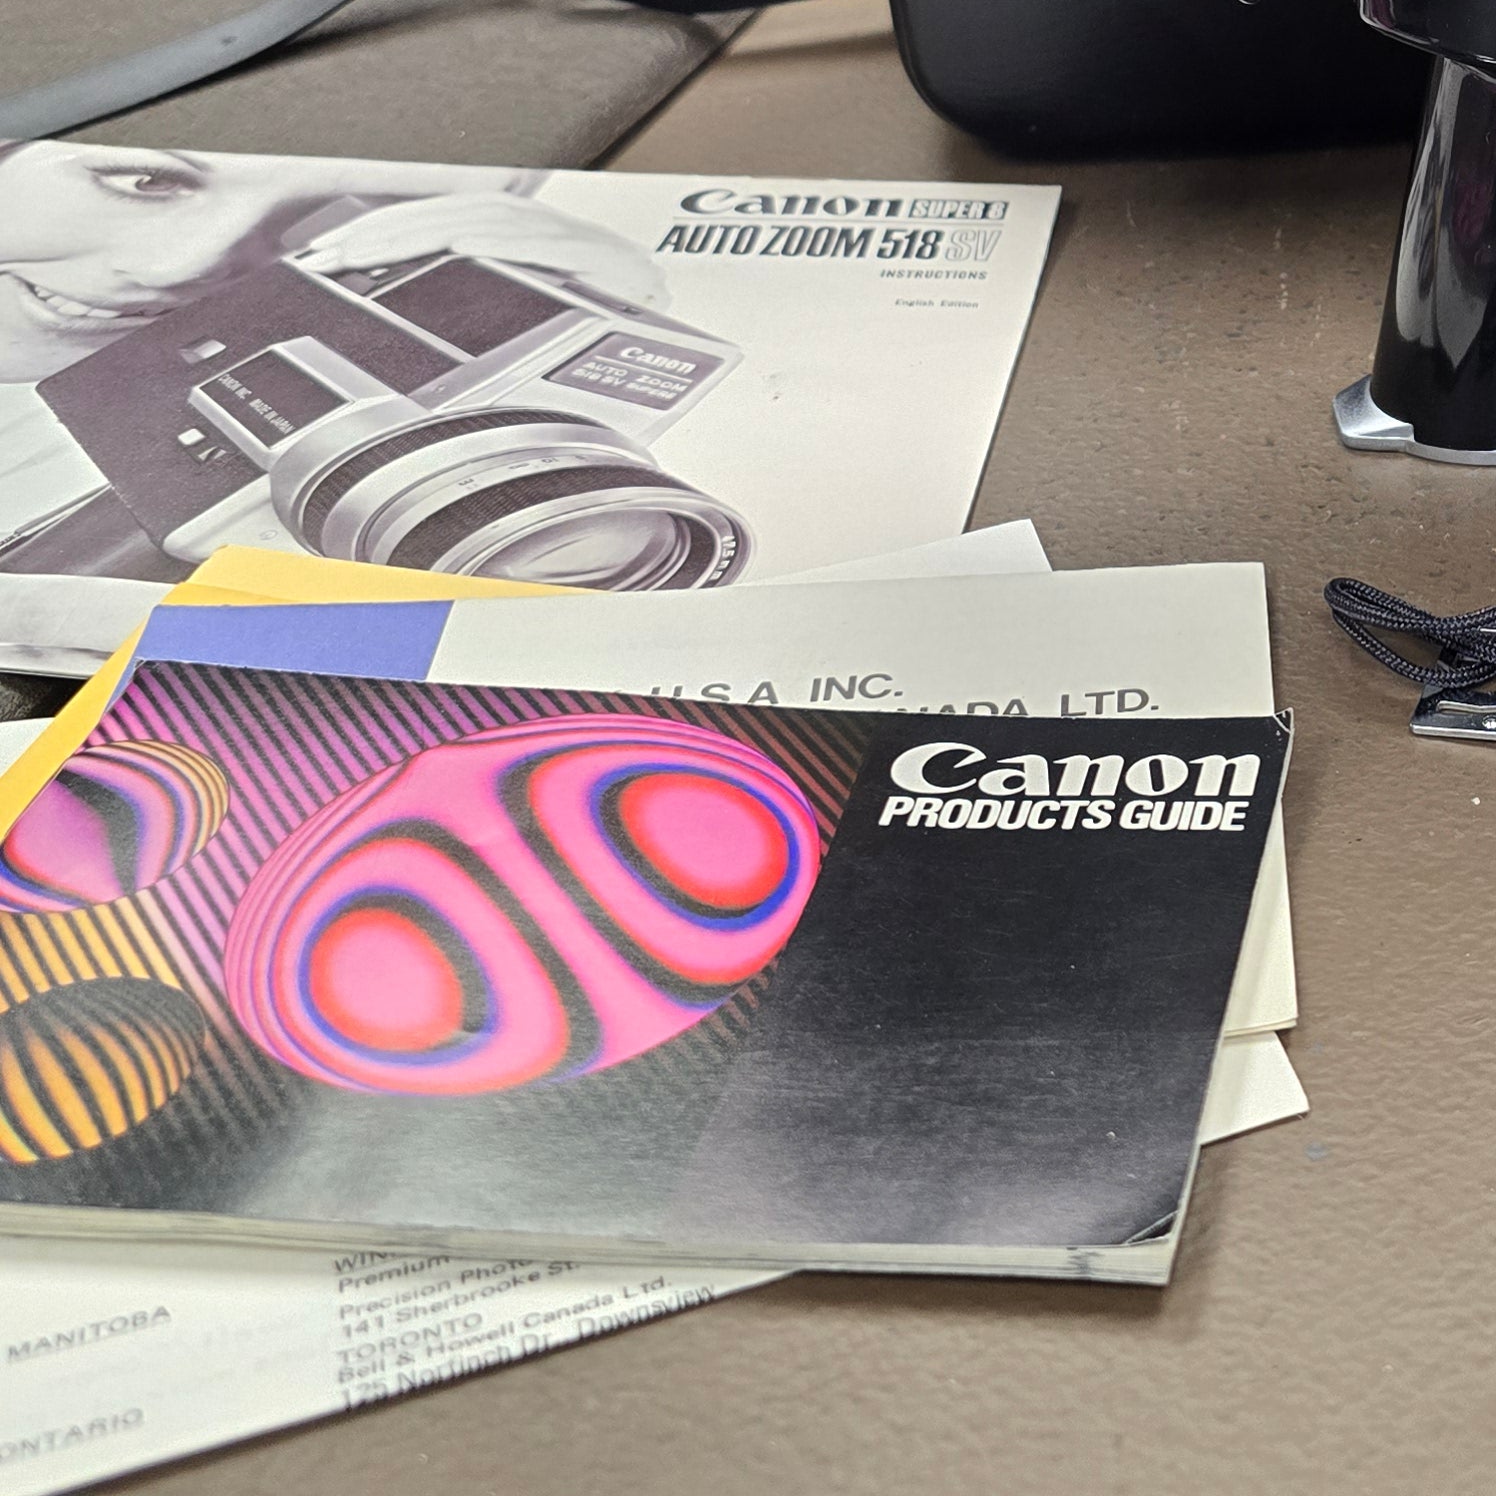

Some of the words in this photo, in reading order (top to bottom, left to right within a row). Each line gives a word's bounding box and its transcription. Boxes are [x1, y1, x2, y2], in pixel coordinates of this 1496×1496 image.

[680, 188, 904, 218] Canon
[656, 224, 760, 255] AUTO
[759, 225, 872, 259] ZOOM
[877, 228, 945, 260] 518
[945, 229, 1003, 261] SV
[880, 269, 988, 280] INSTRUCTIONS
[582, 362, 628, 377] AUTO
[637, 375, 689, 391] ZOOM
[620, 346, 697, 374] Canon
[810, 673, 903, 702] INC.
[1061, 688, 1159, 717] LTD.
[890, 741, 1261, 796] Canon
[878, 795, 1116, 830] PRODUCTS
[1118, 800, 1250, 831] GUIDE
[338, 1255, 451, 1293] Premium
[340, 1280, 451, 1319] Precision
[343, 1315, 384, 1337] 141
[396, 1271, 541, 1322] Sherbrooke
[7, 1305, 172, 1358] MANITOBA
[336, 1313, 483, 1363] TORONTO
[338, 1359, 386, 1383] Bell
[425, 1321, 515, 1357] Howell
[523, 1293, 614, 1328] Canada
